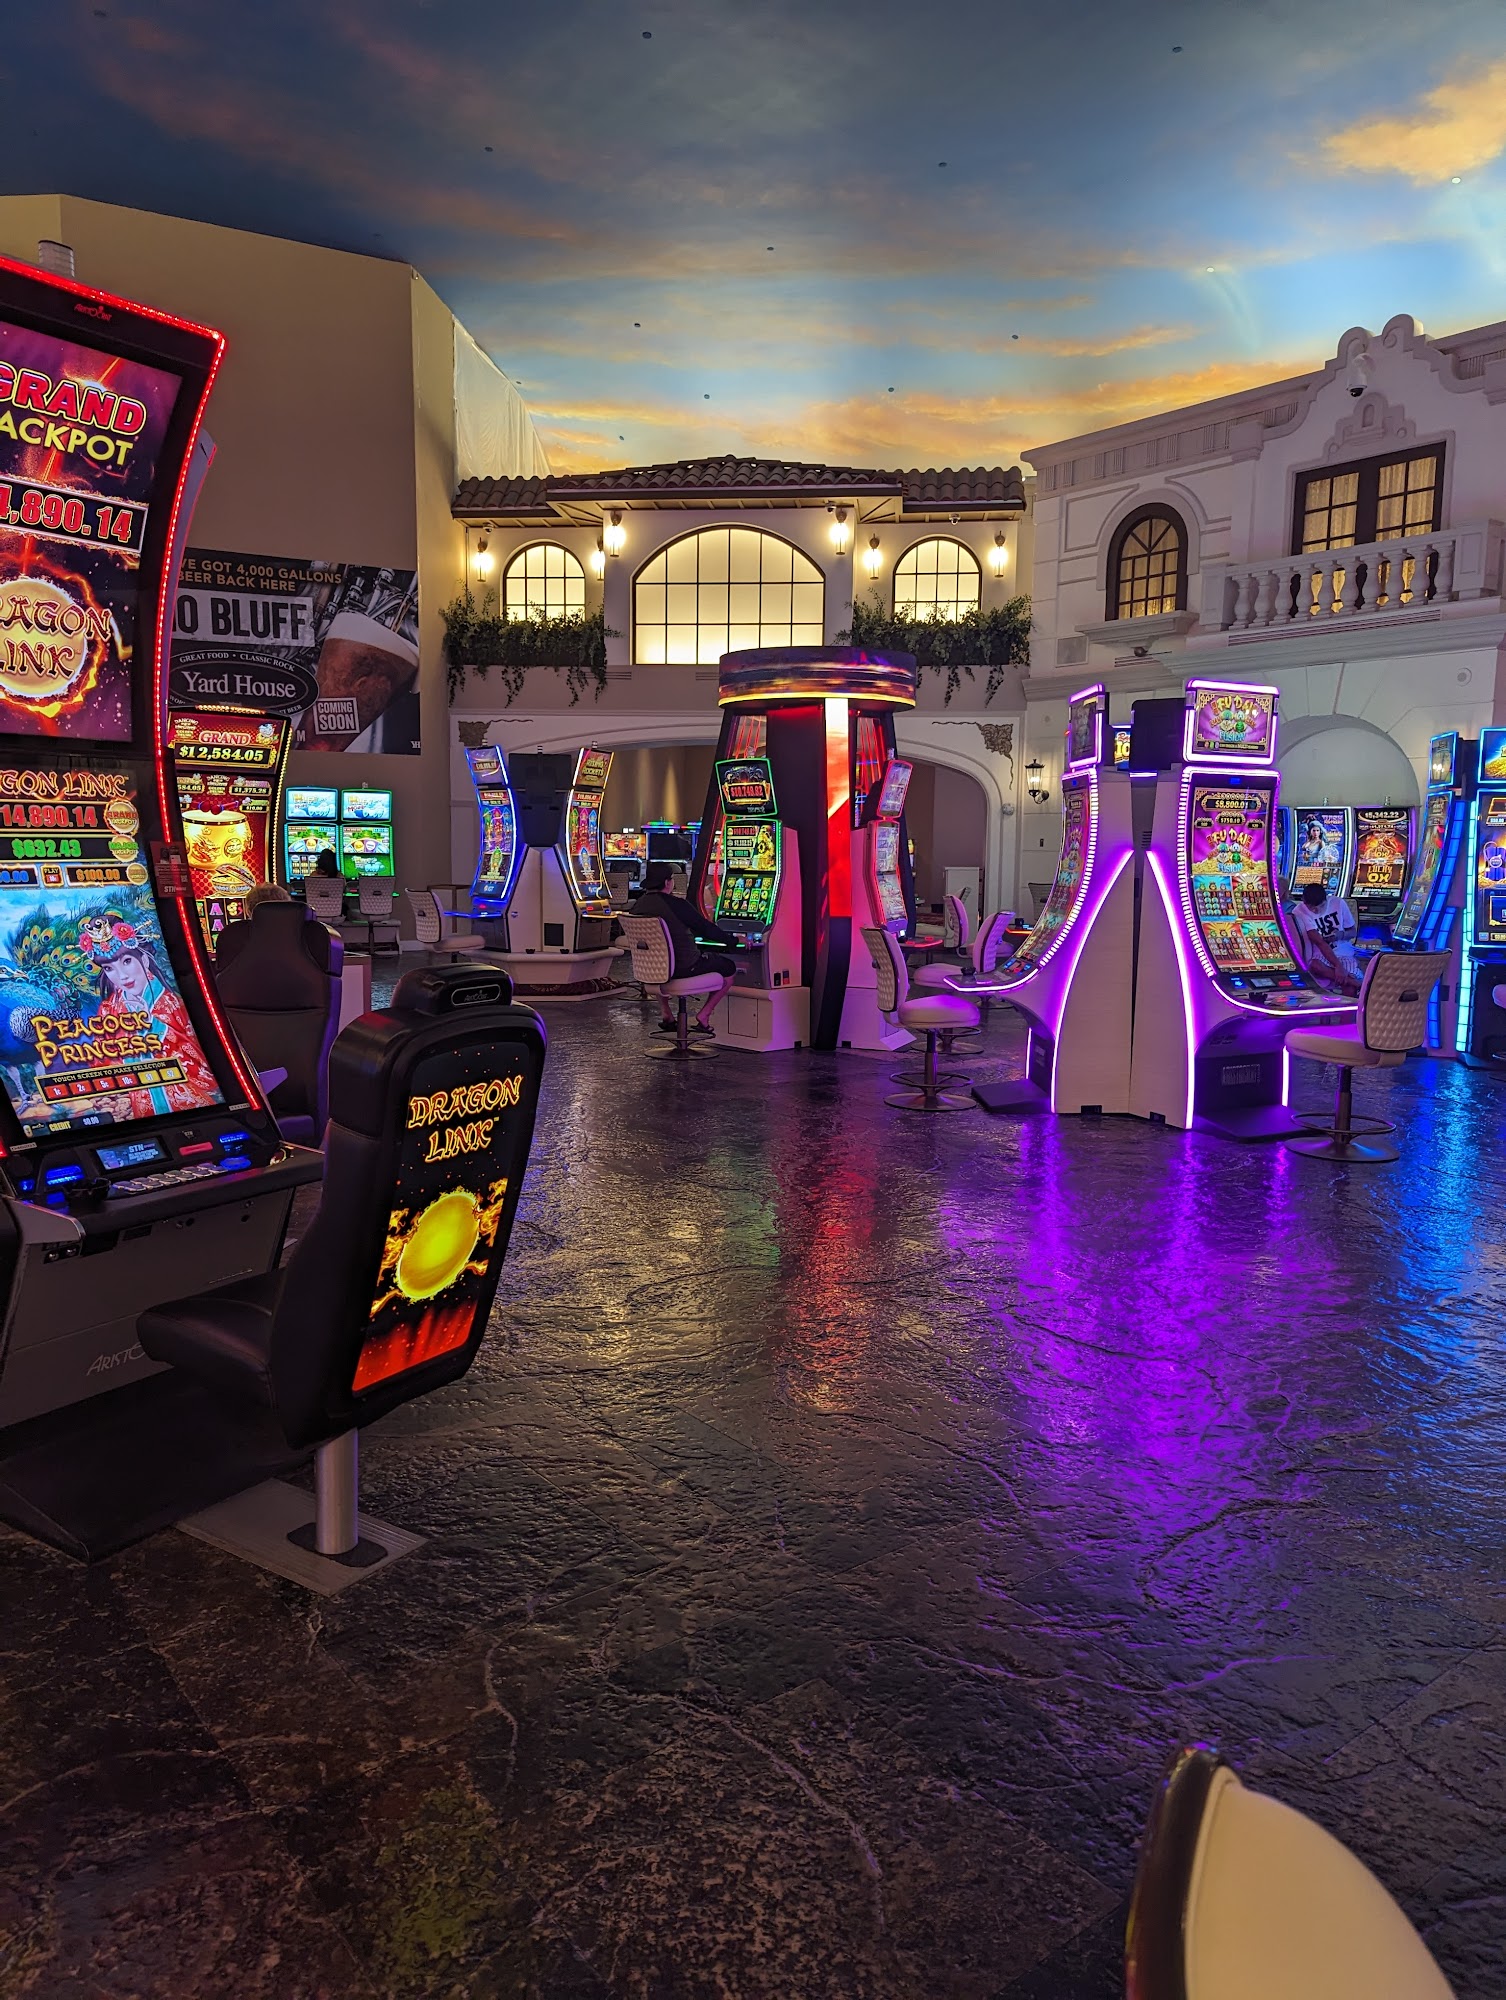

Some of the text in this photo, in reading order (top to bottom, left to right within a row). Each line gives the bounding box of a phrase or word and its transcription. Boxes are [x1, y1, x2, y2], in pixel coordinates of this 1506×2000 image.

[202, 561, 233, 577] GOT
[237, 565, 275, 580] 4,000
[278, 570, 343, 585] GALLONS
[217, 576, 256, 589] BACK
[260, 581, 297, 592] HERE
[0, 595, 112, 642] AGON
[173, 595, 307, 640] O BLUFF
[0, 638, 75, 679] INK
[179, 652, 296, 672] GREAT FOOD CLASSIC ROCK
[181, 671, 297, 699] Yard House
[318, 702, 353, 714] COMING
[319, 713, 356, 731] SOON
[199, 731, 251, 746] GRAND
[1219, 731, 1248, 742] FUSION
[179, 746, 264, 762] $12,584.05
[63, 772, 128, 798] LINK
[111, 818, 137, 826] JACKPOT
[11, 838, 82, 859] $632.43
[108, 841, 140, 851] MAJOR
[1367, 872, 1391, 883] OX
[31, 1011, 152, 1042] PEACOCK
[34, 1034, 163, 1068] PRINCESS
[53, 1076, 77, 1084] TOUCH
[77, 1071, 104, 1081] SCREEN
[114, 1067, 132, 1076] MAKE
[133, 1062, 167, 1072] SELECTION
[408, 1074, 524, 1129] DRAGON
[49, 1121, 72, 1132] CREDIT
[426, 1118, 494, 1162] LINK
